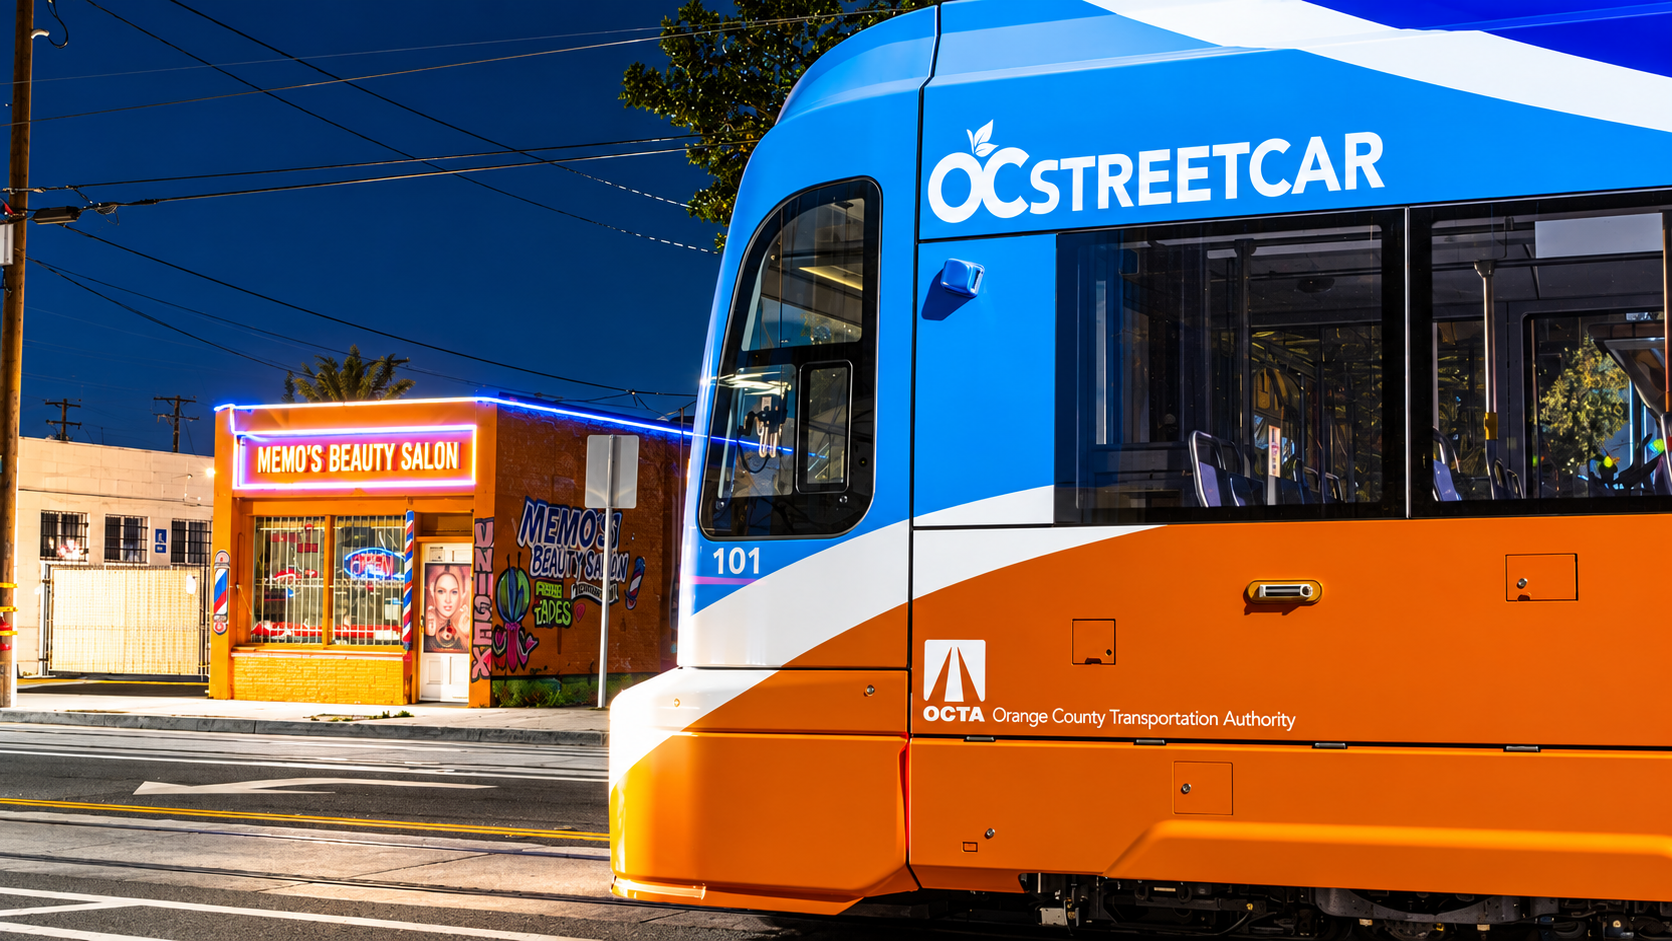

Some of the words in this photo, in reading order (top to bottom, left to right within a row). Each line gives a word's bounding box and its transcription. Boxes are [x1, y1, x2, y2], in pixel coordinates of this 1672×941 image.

[257, 445, 323, 474] MEMO'S
[329, 443, 396, 472] BEAUTY
[401, 441, 460, 470] SALON
[530, 545, 584, 582] BEAUTY
[713, 547, 760, 575] 101
[923, 705, 986, 723] OCTA
[993, 707, 1048, 727] Orange
[1052, 707, 1106, 729] County
[1109, 709, 1219, 730] Transportation
[1223, 711, 1296, 731] Authority
